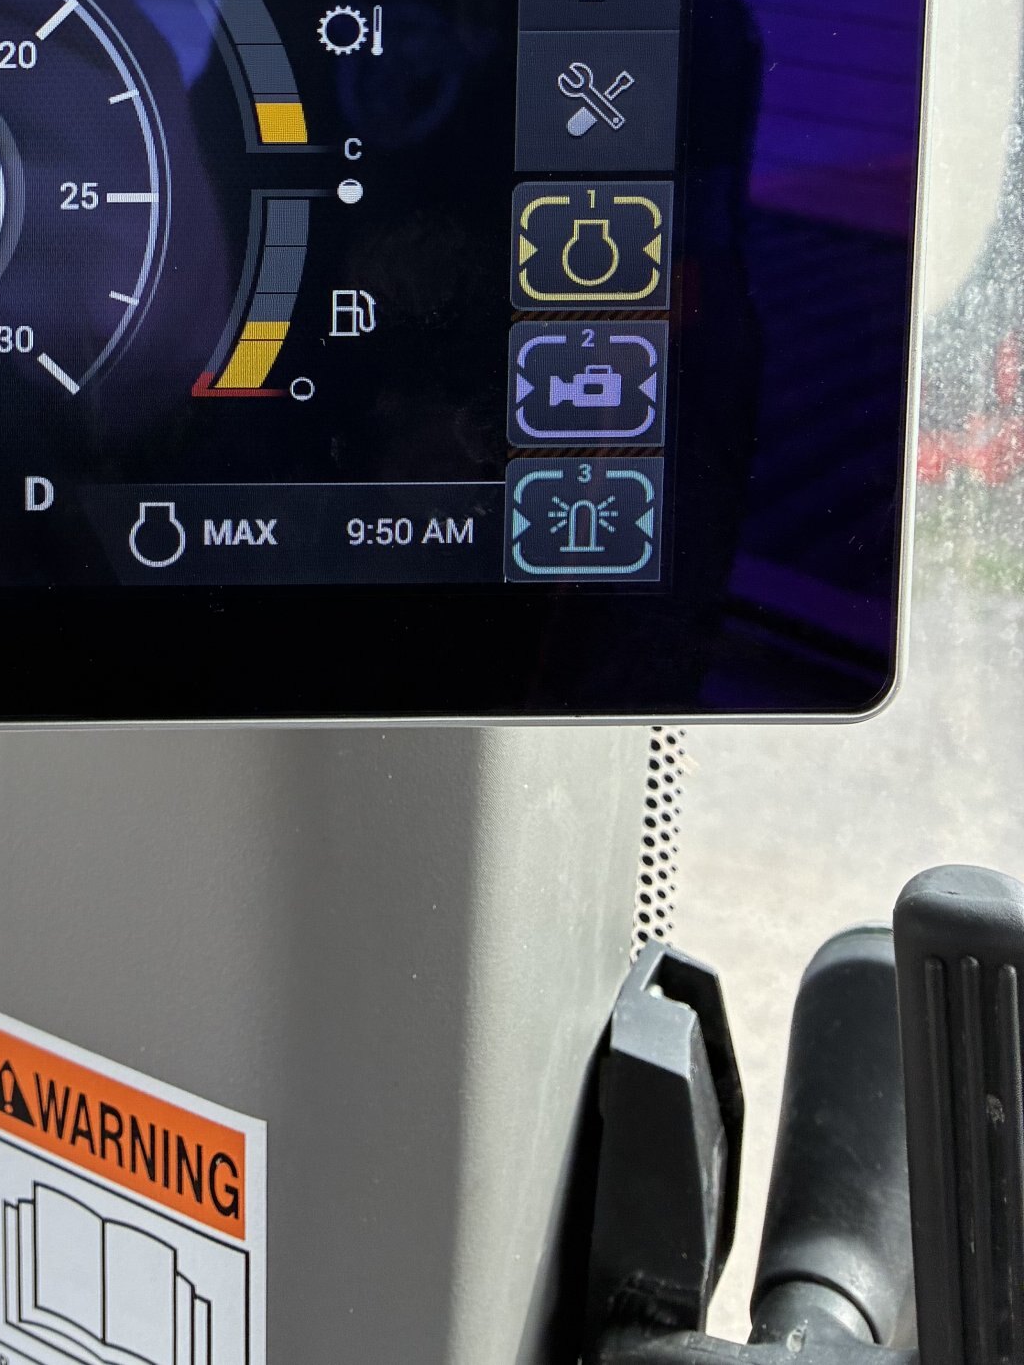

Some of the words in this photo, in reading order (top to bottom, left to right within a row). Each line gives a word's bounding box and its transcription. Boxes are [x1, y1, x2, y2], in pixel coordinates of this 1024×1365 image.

[344, 137, 363, 161] C
[59, 181, 99, 210] 25
[587, 189, 596, 209] 1
[581, 328, 596, 348] 2
[577, 463, 593, 484] 3
[25, 475, 56, 512] D
[203, 518, 278, 546] MAX
[347, 517, 414, 546] 9:50
[421, 517, 474, 545] AM
[34, 1071, 240, 1220] WARNING
